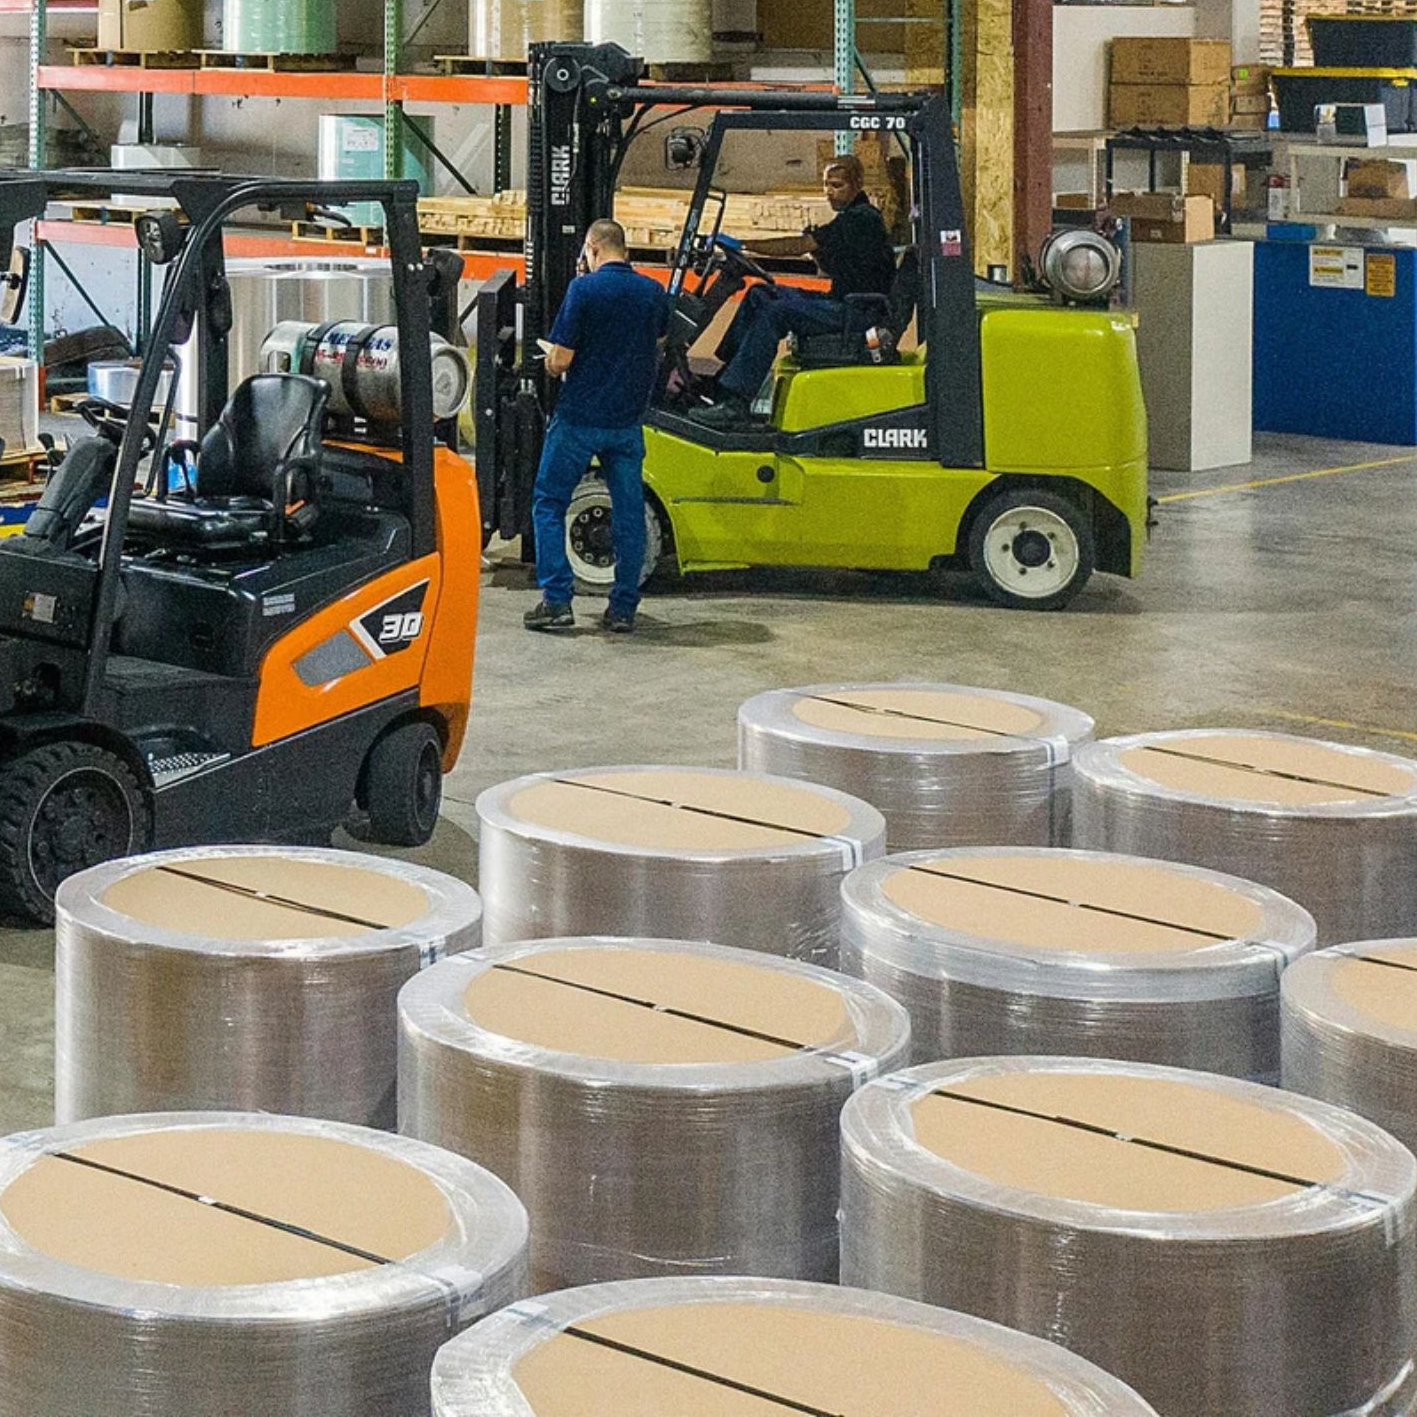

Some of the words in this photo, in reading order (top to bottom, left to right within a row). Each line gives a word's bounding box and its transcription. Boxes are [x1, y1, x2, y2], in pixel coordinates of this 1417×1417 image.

[850, 116, 881, 129] CGC
[885, 116, 906, 129] 70
[551, 144, 570, 205] CLARK
[864, 428, 928, 448] CLARK
[379, 611, 424, 644] 30
